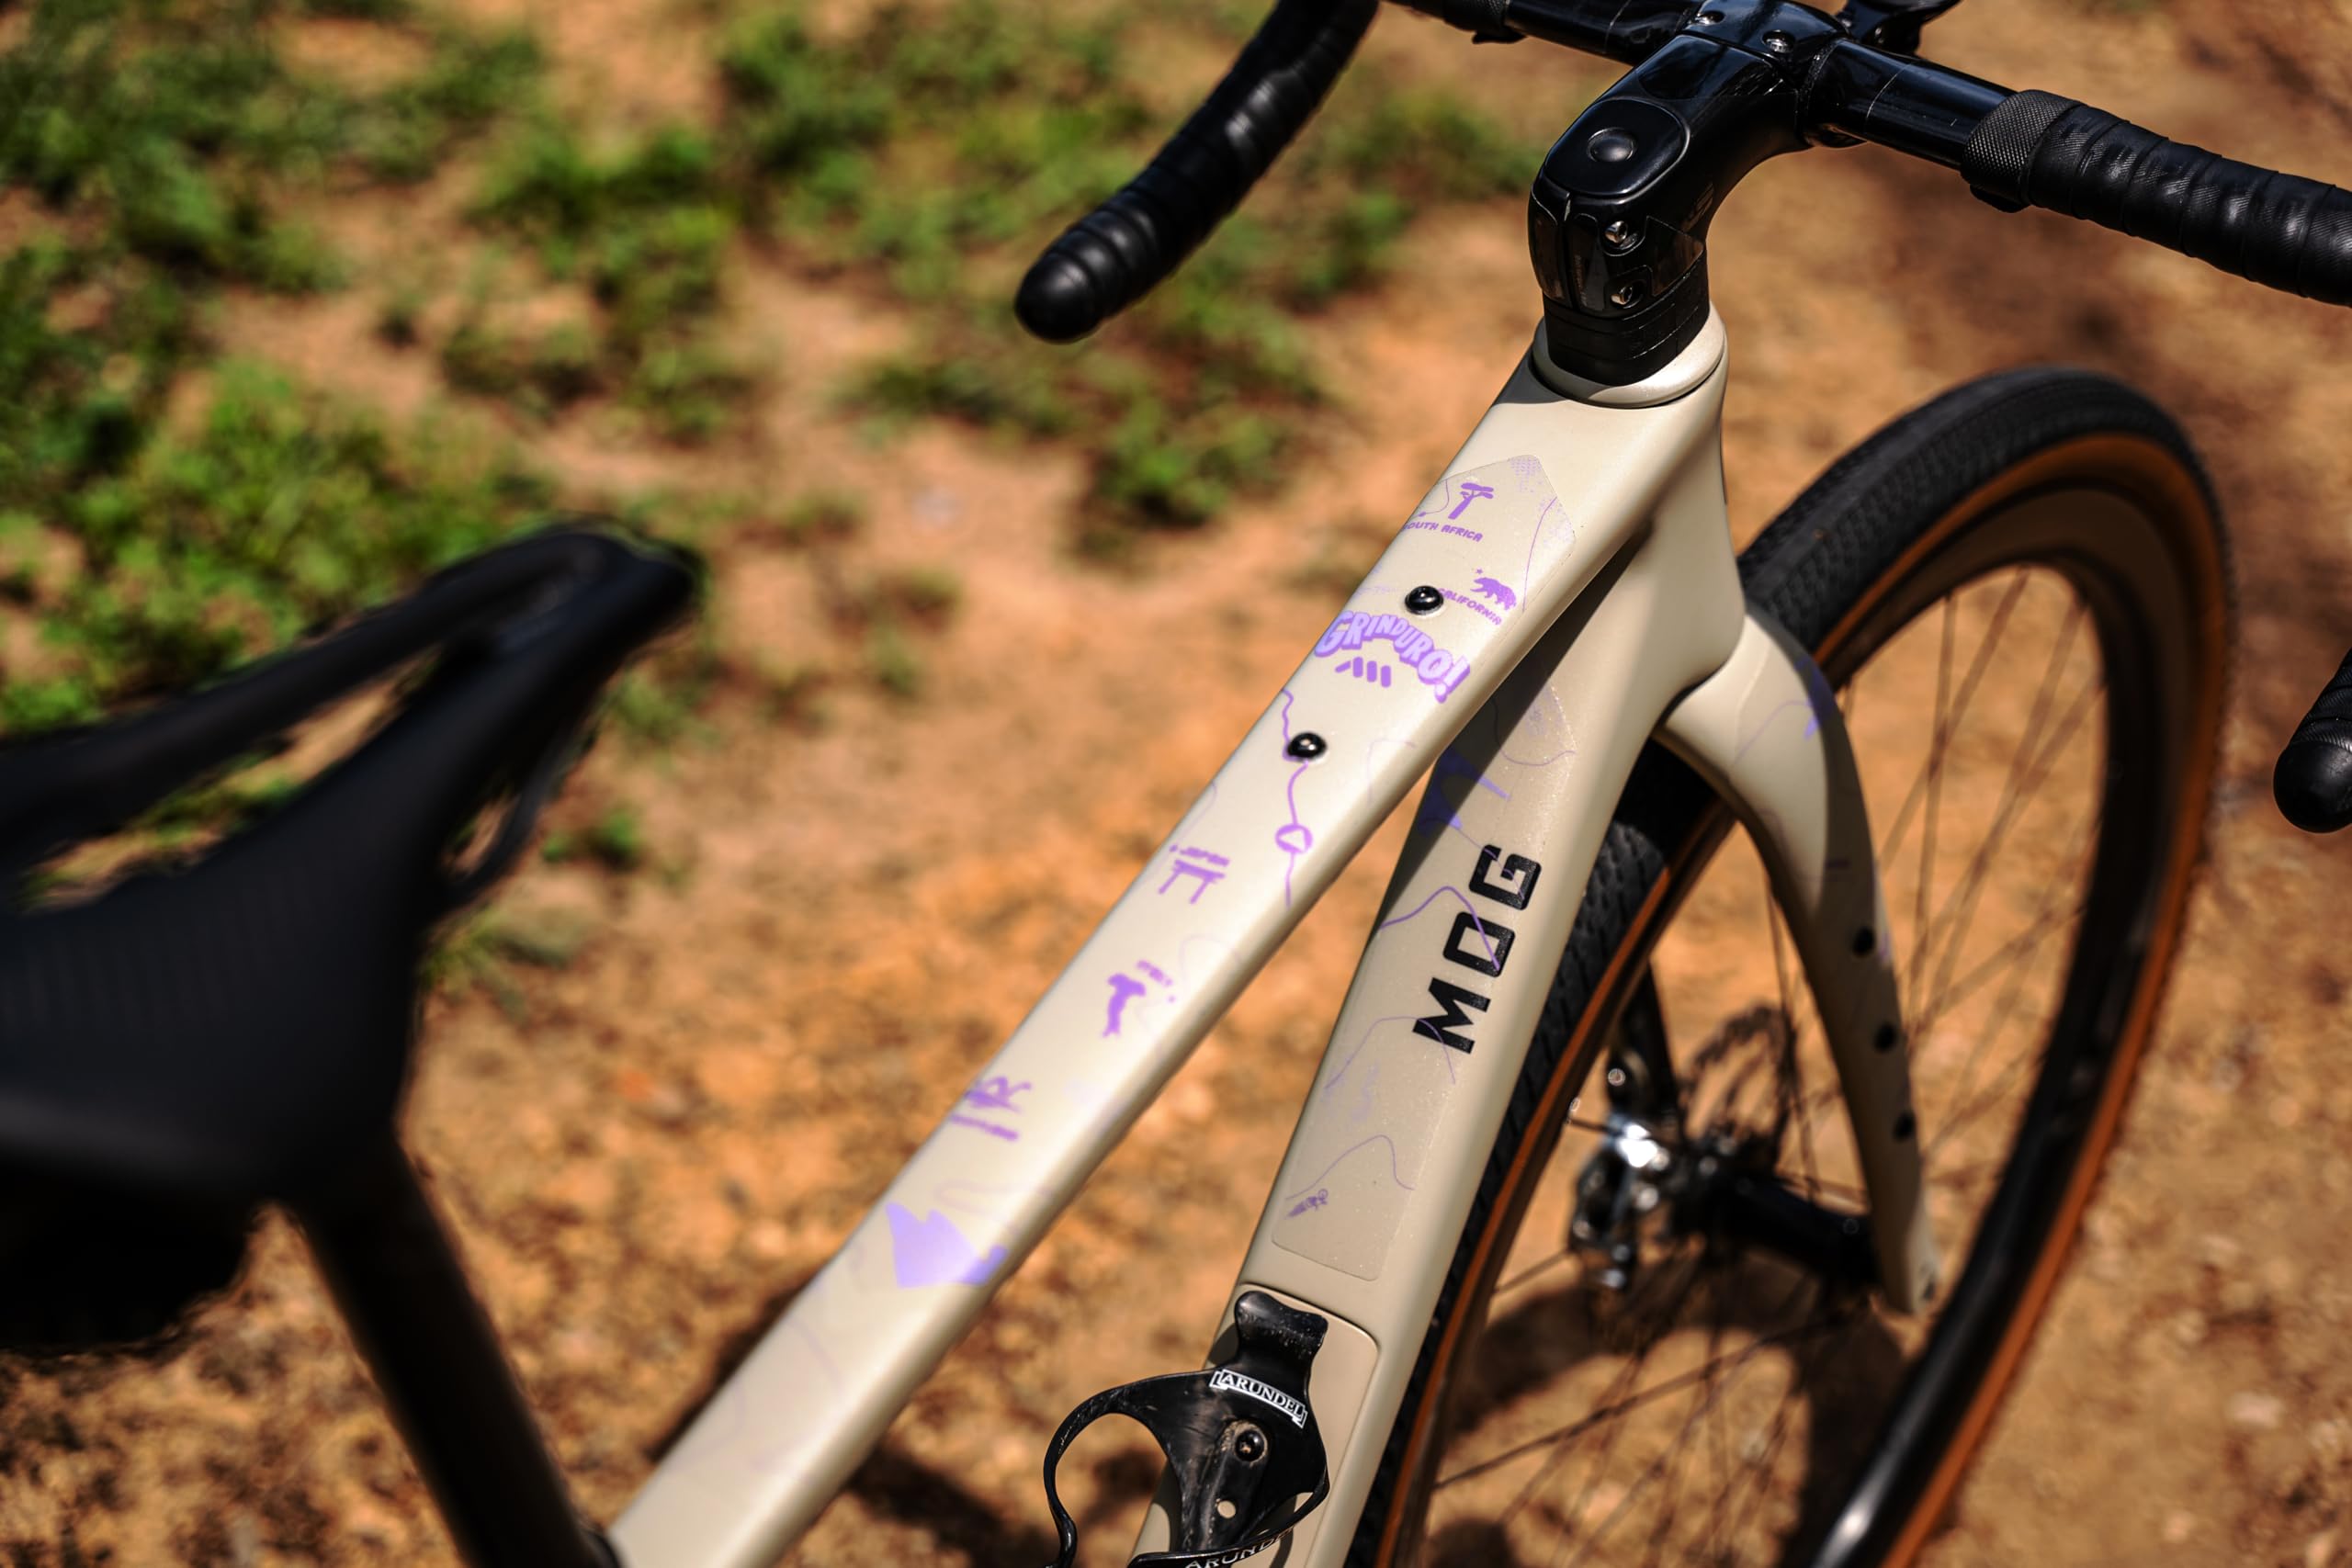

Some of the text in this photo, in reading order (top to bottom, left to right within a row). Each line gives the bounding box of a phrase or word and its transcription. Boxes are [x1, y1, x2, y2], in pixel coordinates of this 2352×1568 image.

[1441, 525, 1484, 542] AFRICA
[1314, 610, 1471, 704] GRINDURO!
[1412, 844, 1542, 1055] MOG
[1221, 1373, 1303, 1418] ARUNDEL
[1184, 1527, 1292, 1568] ARUND
